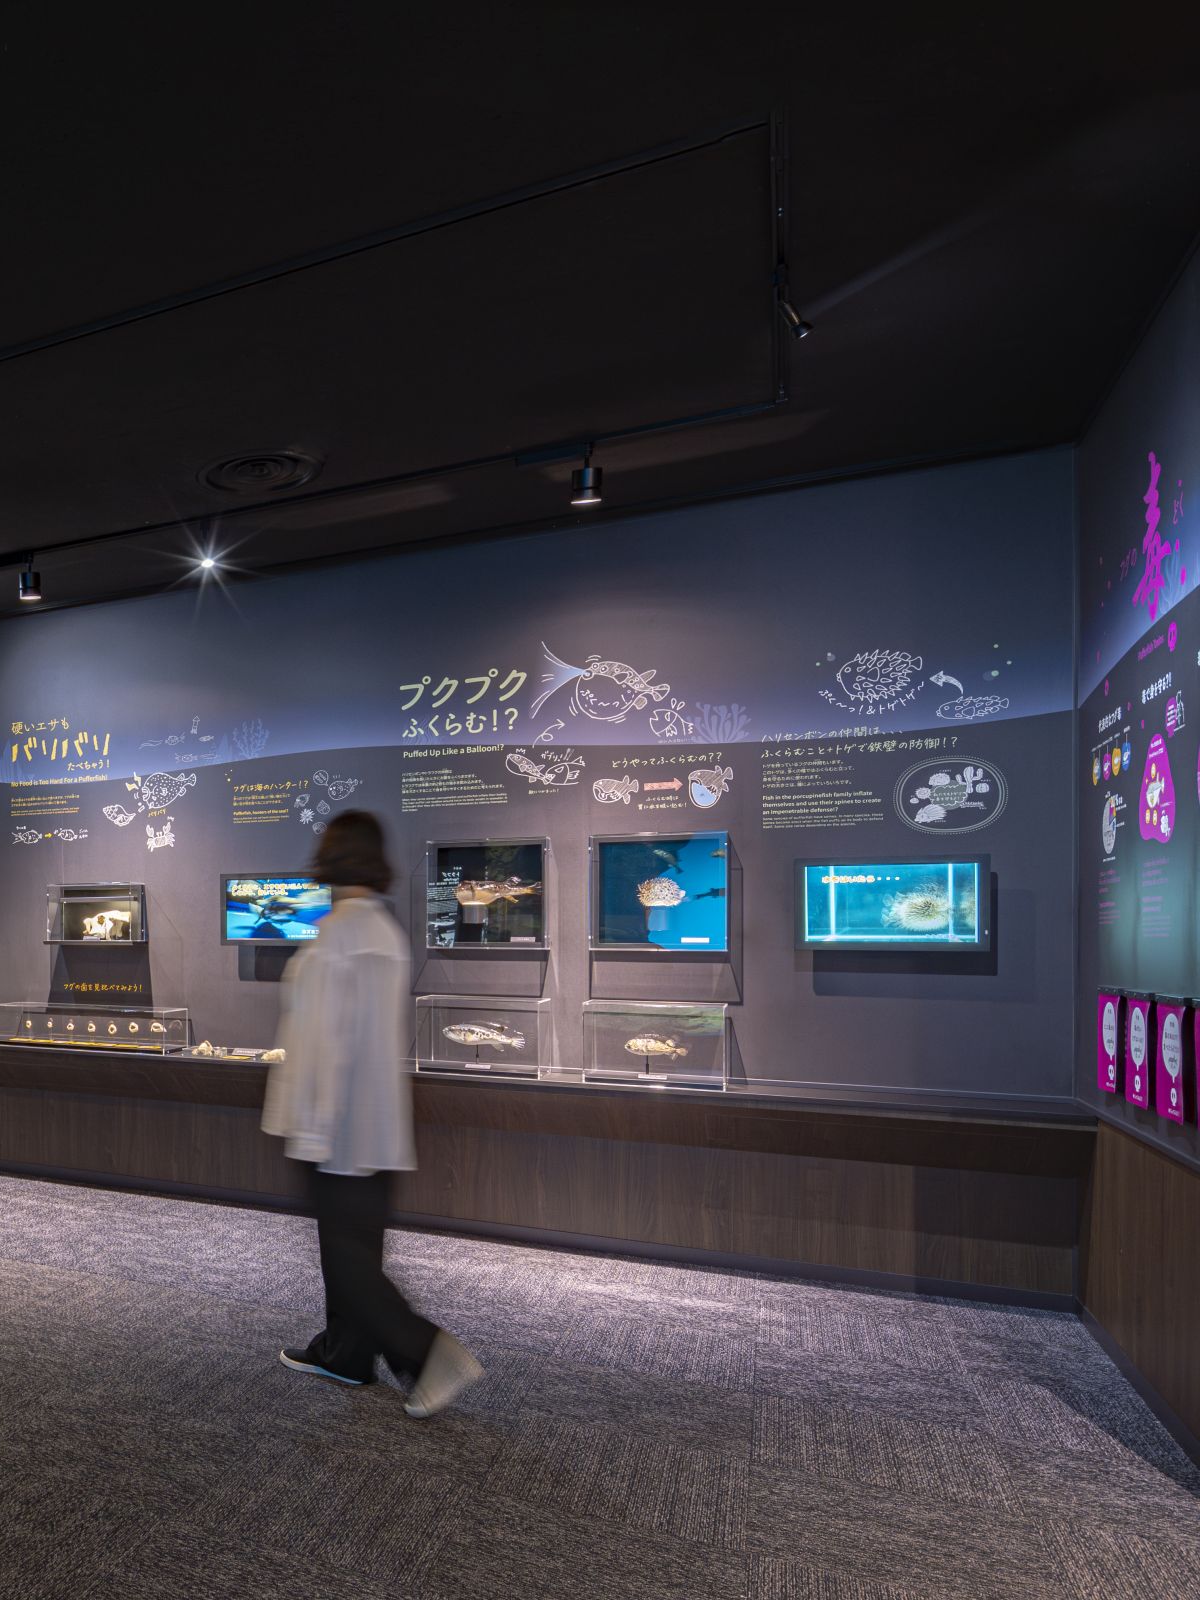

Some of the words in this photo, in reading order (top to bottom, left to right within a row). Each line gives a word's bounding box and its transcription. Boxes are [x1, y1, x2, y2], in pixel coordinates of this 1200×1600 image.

[400, 668, 527, 711] プクプク
[11, 717, 69, 735] 硬いエサも
[402, 708, 519, 738] ふくらむ!?
[11, 731, 110, 763] バリバリ
[403, 750, 428, 759] Puffed
[429, 749, 440, 758] Up
[442, 747, 458, 756] Like
[466, 744, 505, 754] Balloon!?
[67, 759, 110, 771] たべちゃう!
[50, 777, 63, 785] Hard
[792, 792, 832, 800] porcupinefish
[770, 808, 809, 816] impenetrable
[64, 982, 142, 992] フグの歯を見比べてみよう!
